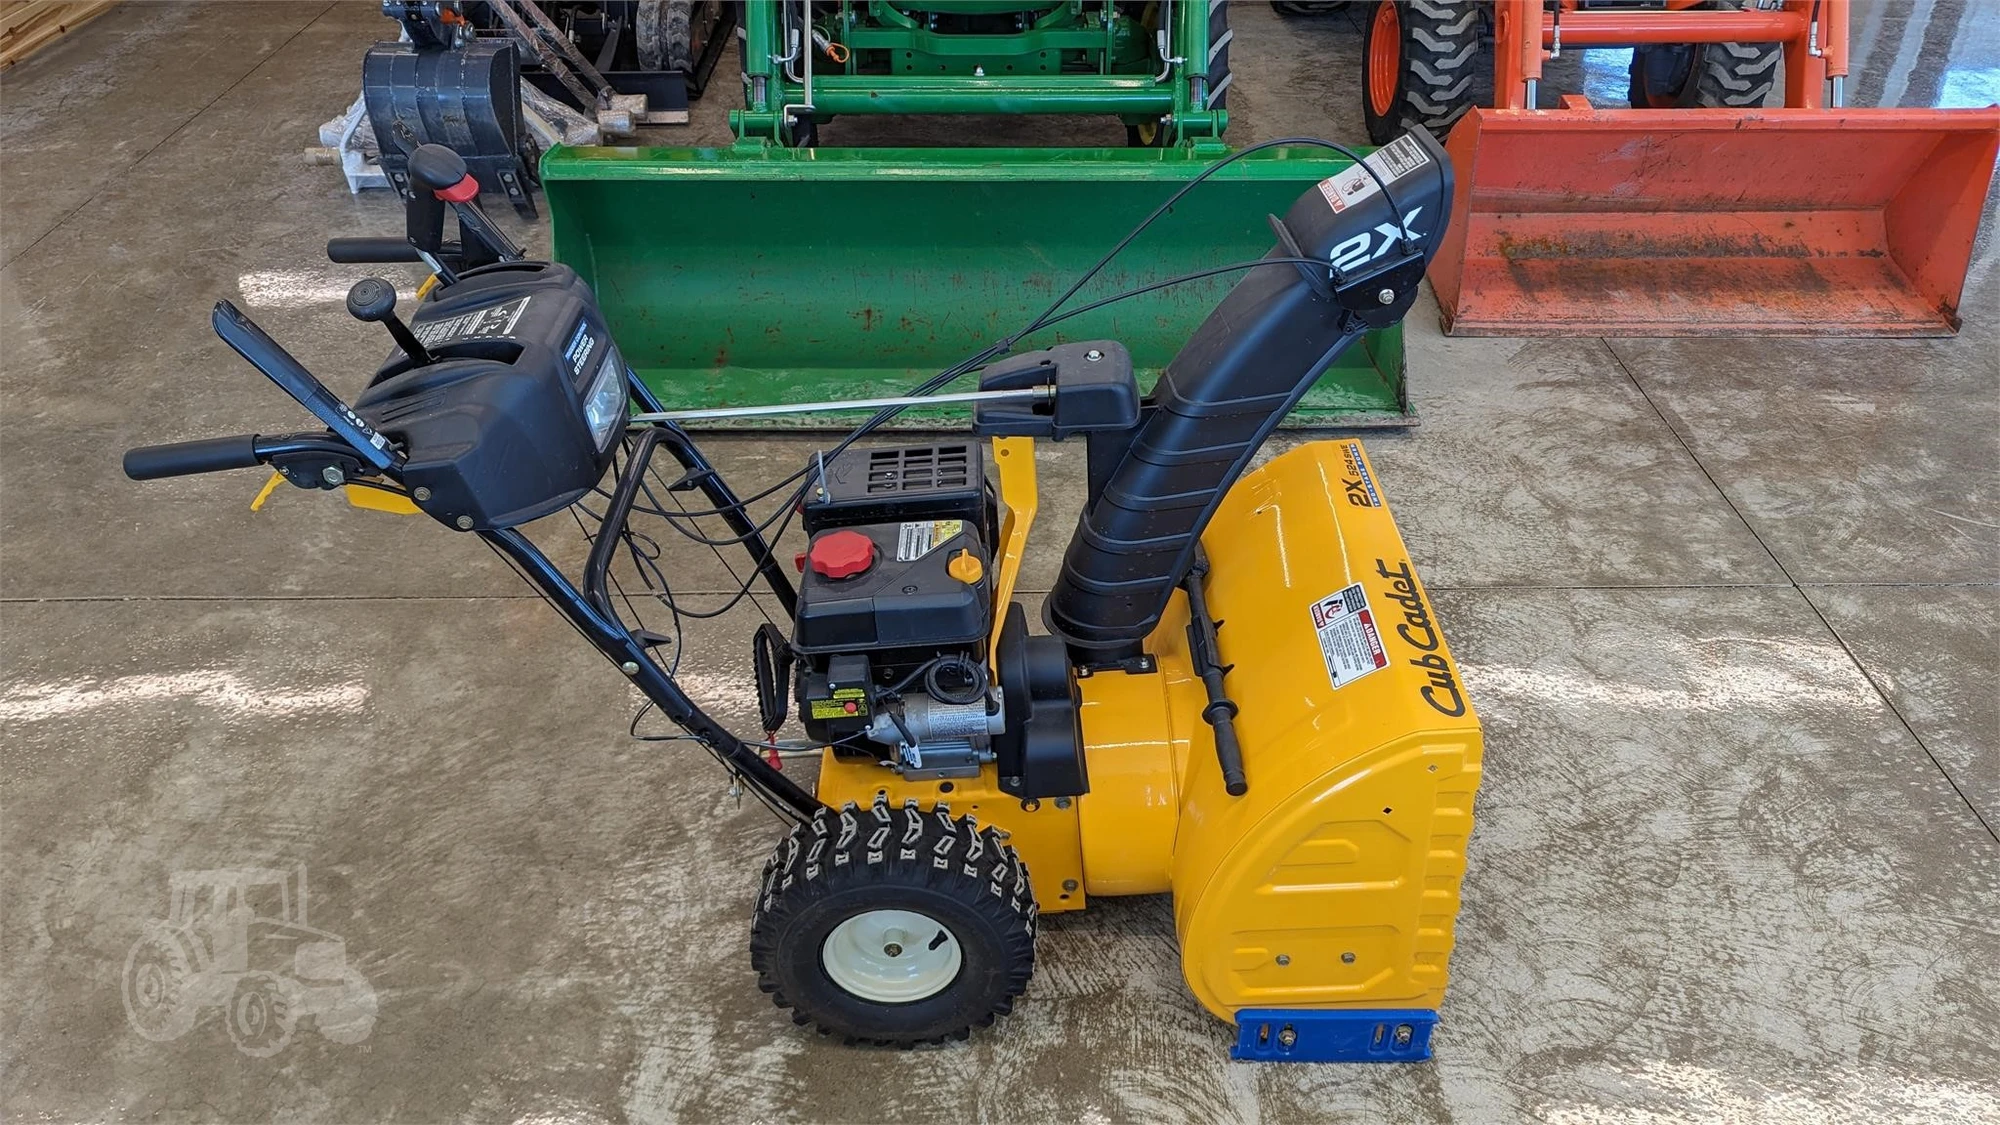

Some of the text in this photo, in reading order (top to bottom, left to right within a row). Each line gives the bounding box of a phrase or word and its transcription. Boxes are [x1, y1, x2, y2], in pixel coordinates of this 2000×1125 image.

[1329, 206, 1422, 278] 2X
[573, 334, 588, 363] POWER
[574, 337, 594, 375] STEERING
[1350, 444, 1364, 466] POWER
[1341, 478, 1372, 507] 2X
[1366, 627, 1381, 655] DANGER
[1376, 559, 1465, 717] Cub Cadet
